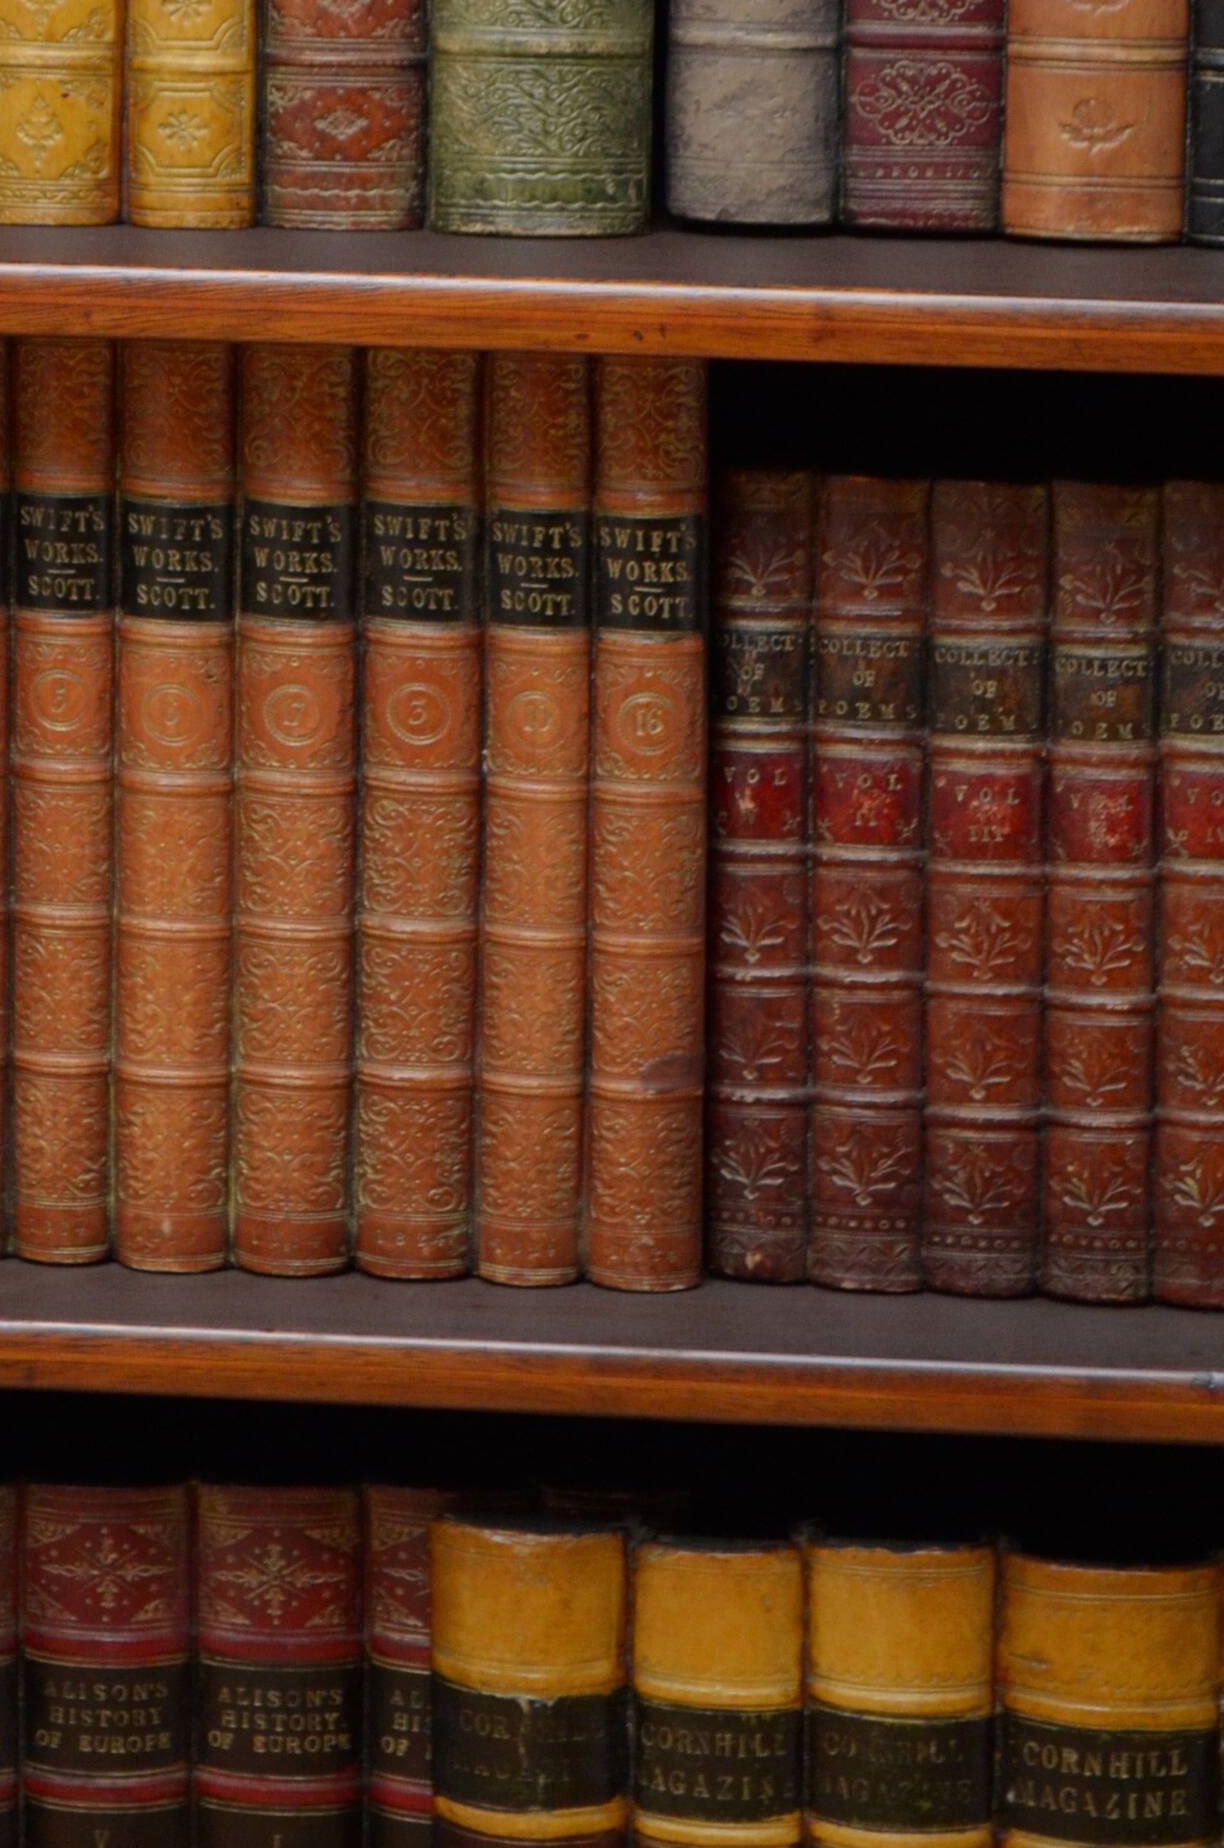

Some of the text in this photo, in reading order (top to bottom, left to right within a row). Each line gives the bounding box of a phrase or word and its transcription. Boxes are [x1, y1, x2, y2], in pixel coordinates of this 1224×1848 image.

[20, 503, 106, 533] SWIFT'S
[127, 511, 225, 542] SWIFT'S
[248, 513, 343, 545] SWIFT'S
[373, 511, 468, 542] SWIFT'S
[491, 520, 584, 550] SWIFT'S
[599, 523, 697, 553] SWIFT'S
[24, 538, 105, 564] WORKS.
[132, 544, 220, 573] WORKS.
[253, 546, 338, 574] WORKS.
[379, 545, 464, 572] WORKS.
[136, 583, 218, 610] SCOTT.
[255, 581, 336, 609] SCOTT.
[499, 589, 577, 616] SCOTT.
[851, 669, 876, 688] OF
[971, 679, 999, 700] OF
[406, 698, 427, 727] 3
[726, 695, 804, 714] OEMS
[817, 699, 918, 720] POEMS
[1094, 689, 1118, 709] OF
[632, 707, 666, 738] 16
[724, 766, 790, 787] VOL
[834, 772, 904, 792] VOL
[953, 784, 1022, 806] VOL
[44, 1679, 169, 1703] ALISON'S
[216, 1685, 344, 1708] ALISON'S
[48, 1706, 162, 1728] HISTORY
[219, 1708, 338, 1732] HISTORY
[34, 1727, 173, 1754] OF EUROPE
[207, 1729, 353, 1755] OF EUROPE
[379, 1735, 411, 1757] OF
[640, 1722, 789, 1759] CORNHILL
[1022, 1739, 1190, 1781] CORNHILL
[1014, 1776, 1192, 1821] MAGAZINE
